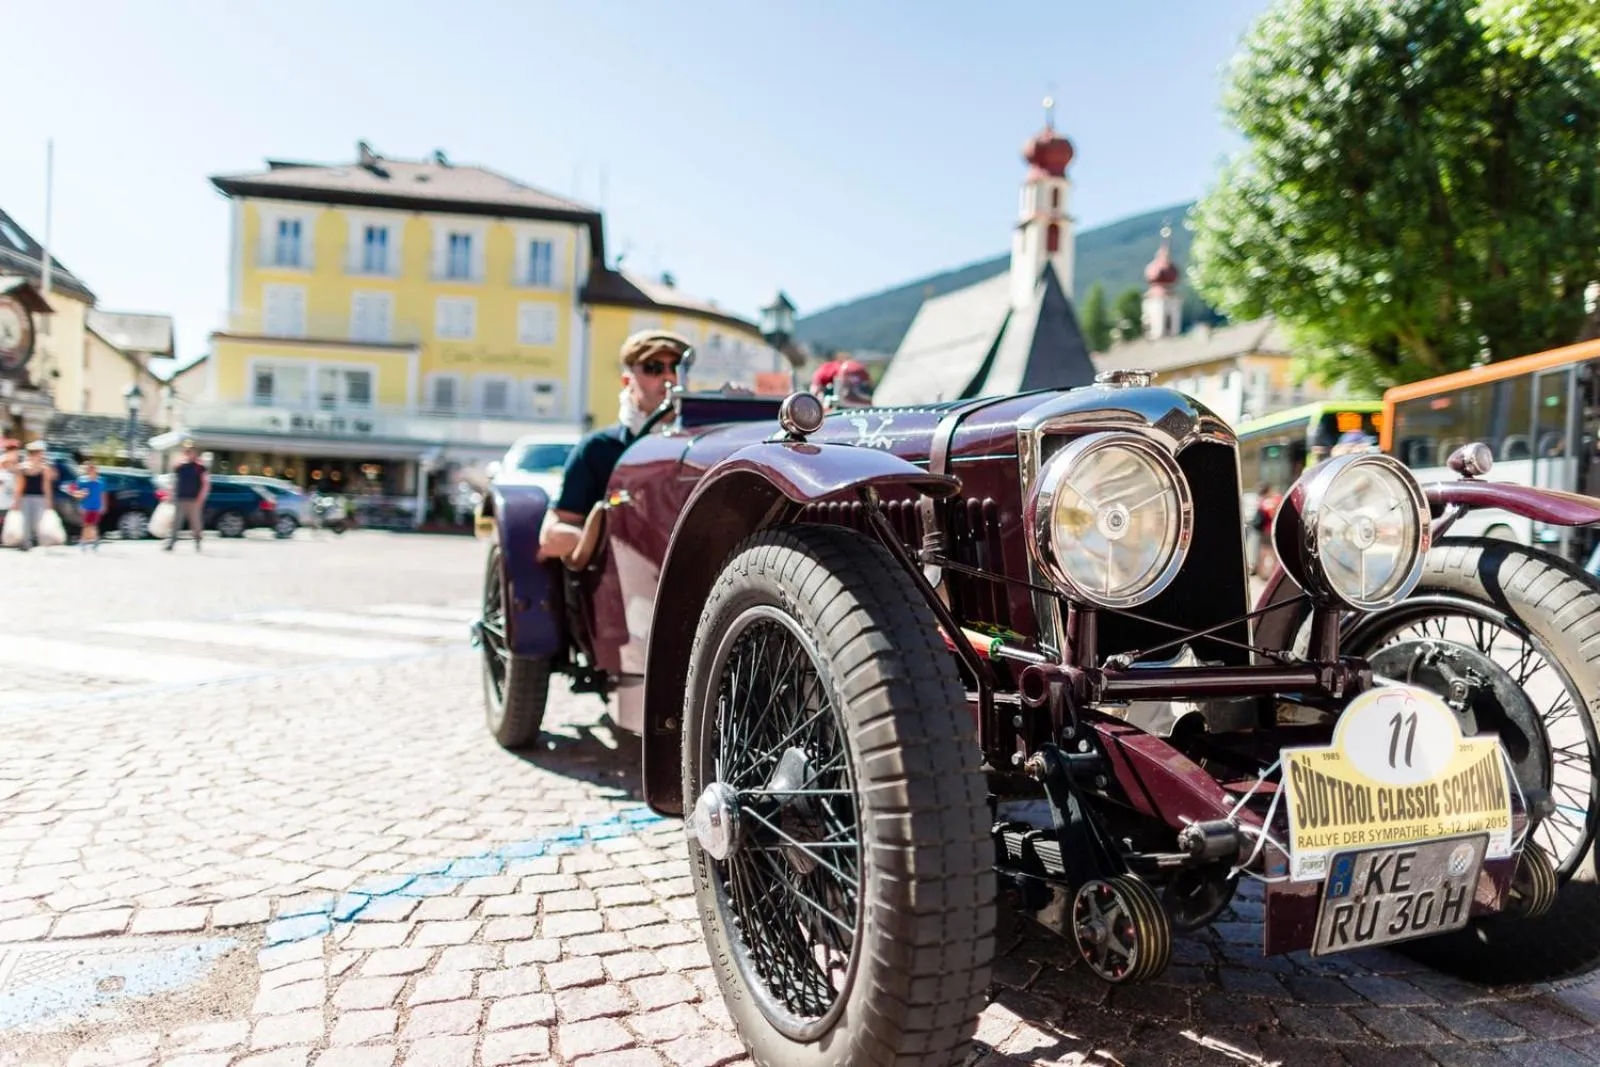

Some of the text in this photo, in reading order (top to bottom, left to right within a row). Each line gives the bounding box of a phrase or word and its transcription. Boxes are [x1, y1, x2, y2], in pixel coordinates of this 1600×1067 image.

[1388, 712, 1418, 768] 11
[1291, 749, 1506, 830] SÜDTIROL CLASSIC SCHENNA
[1297, 833, 1340, 849] RALLYE
[1343, 829, 1366, 844] DER
[1368, 825, 1429, 843] SYMPATHIE
[1485, 816, 1508, 830] 2015
[1365, 851, 1416, 896] KE
[1327, 900, 1381, 948] RU
